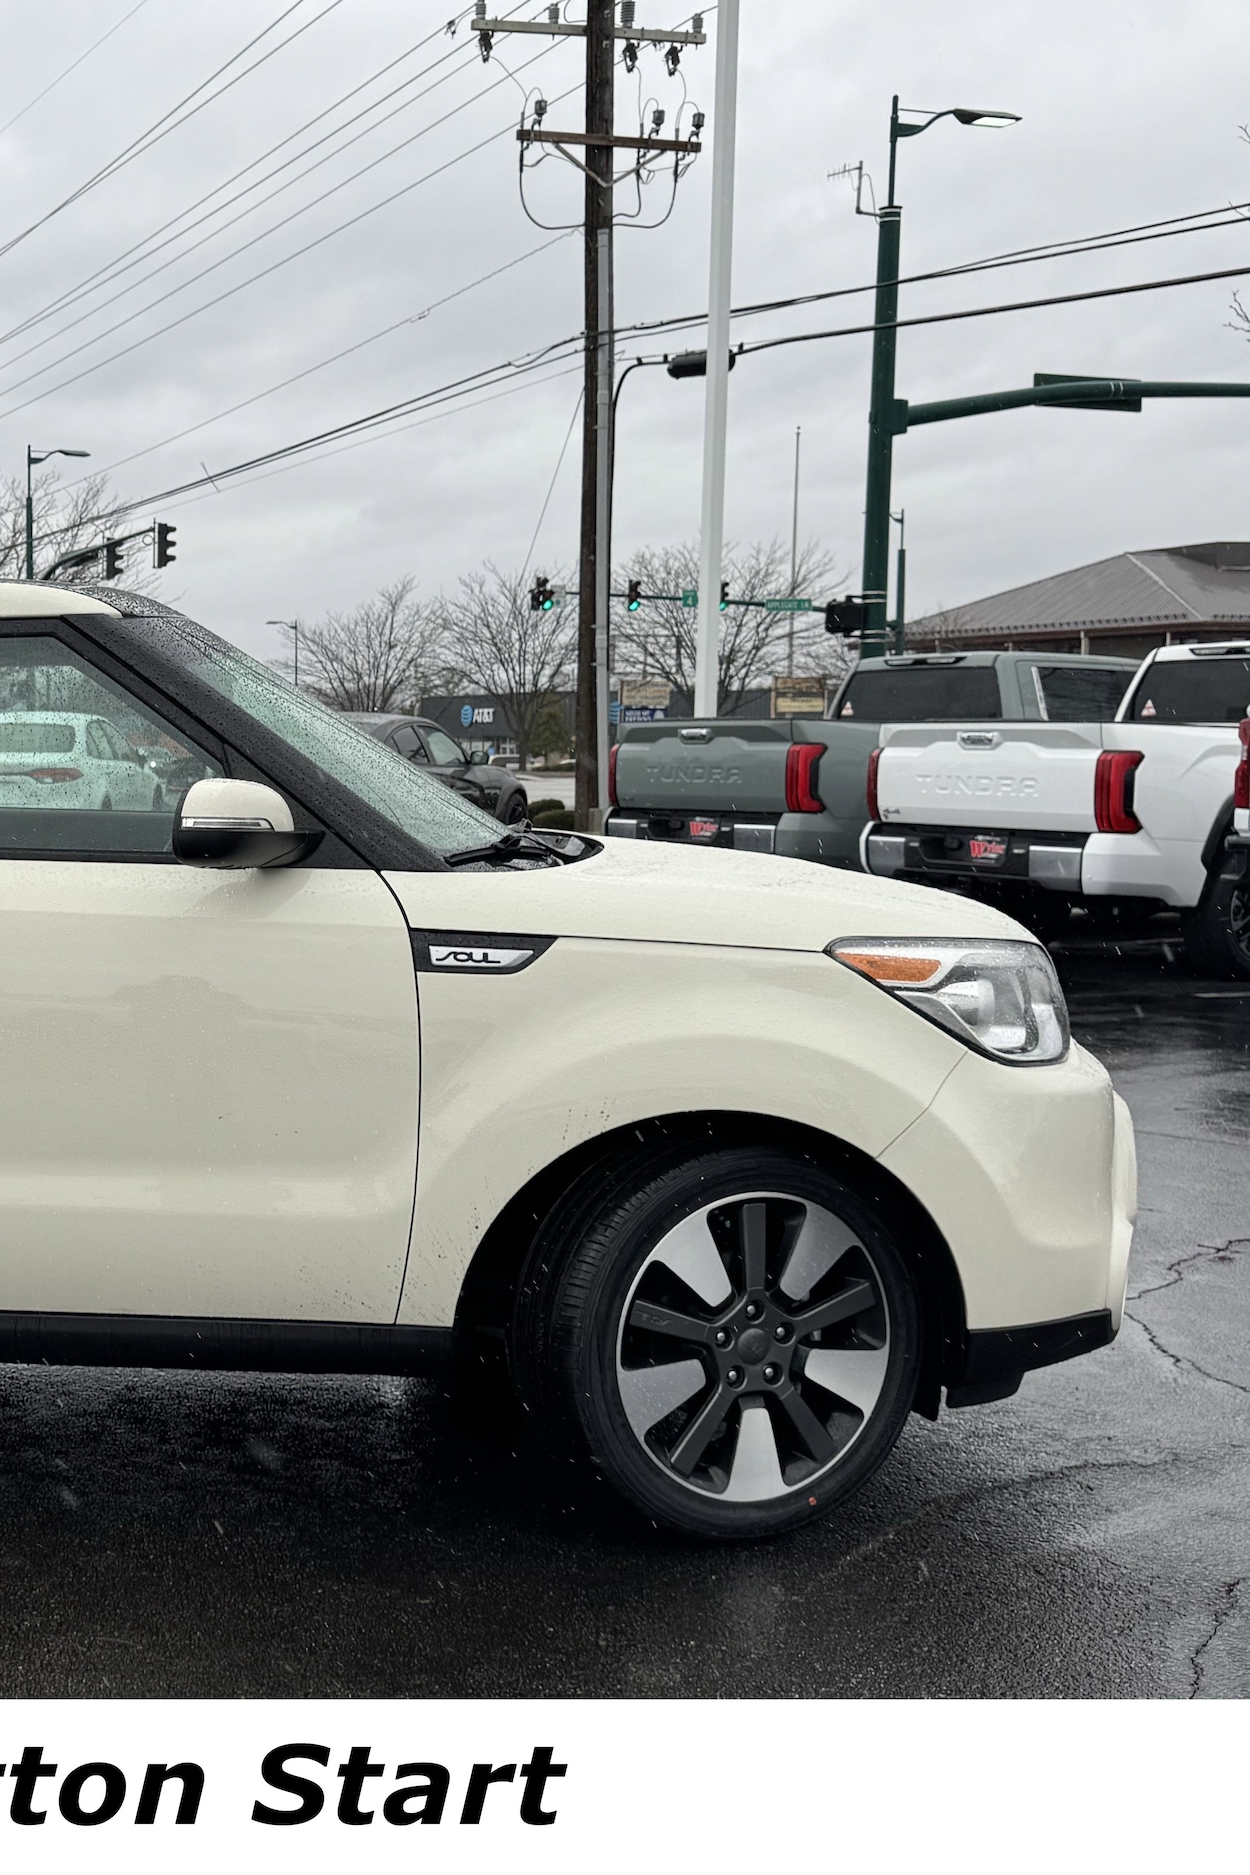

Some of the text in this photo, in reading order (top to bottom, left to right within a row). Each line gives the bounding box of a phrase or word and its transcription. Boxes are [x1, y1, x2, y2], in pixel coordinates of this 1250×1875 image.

[472, 707, 495, 724] AT&T
[646, 765, 743, 784] TUNDRA
[915, 773, 1040, 798] TUNDRA
[435, 951, 502, 964] SOUL
